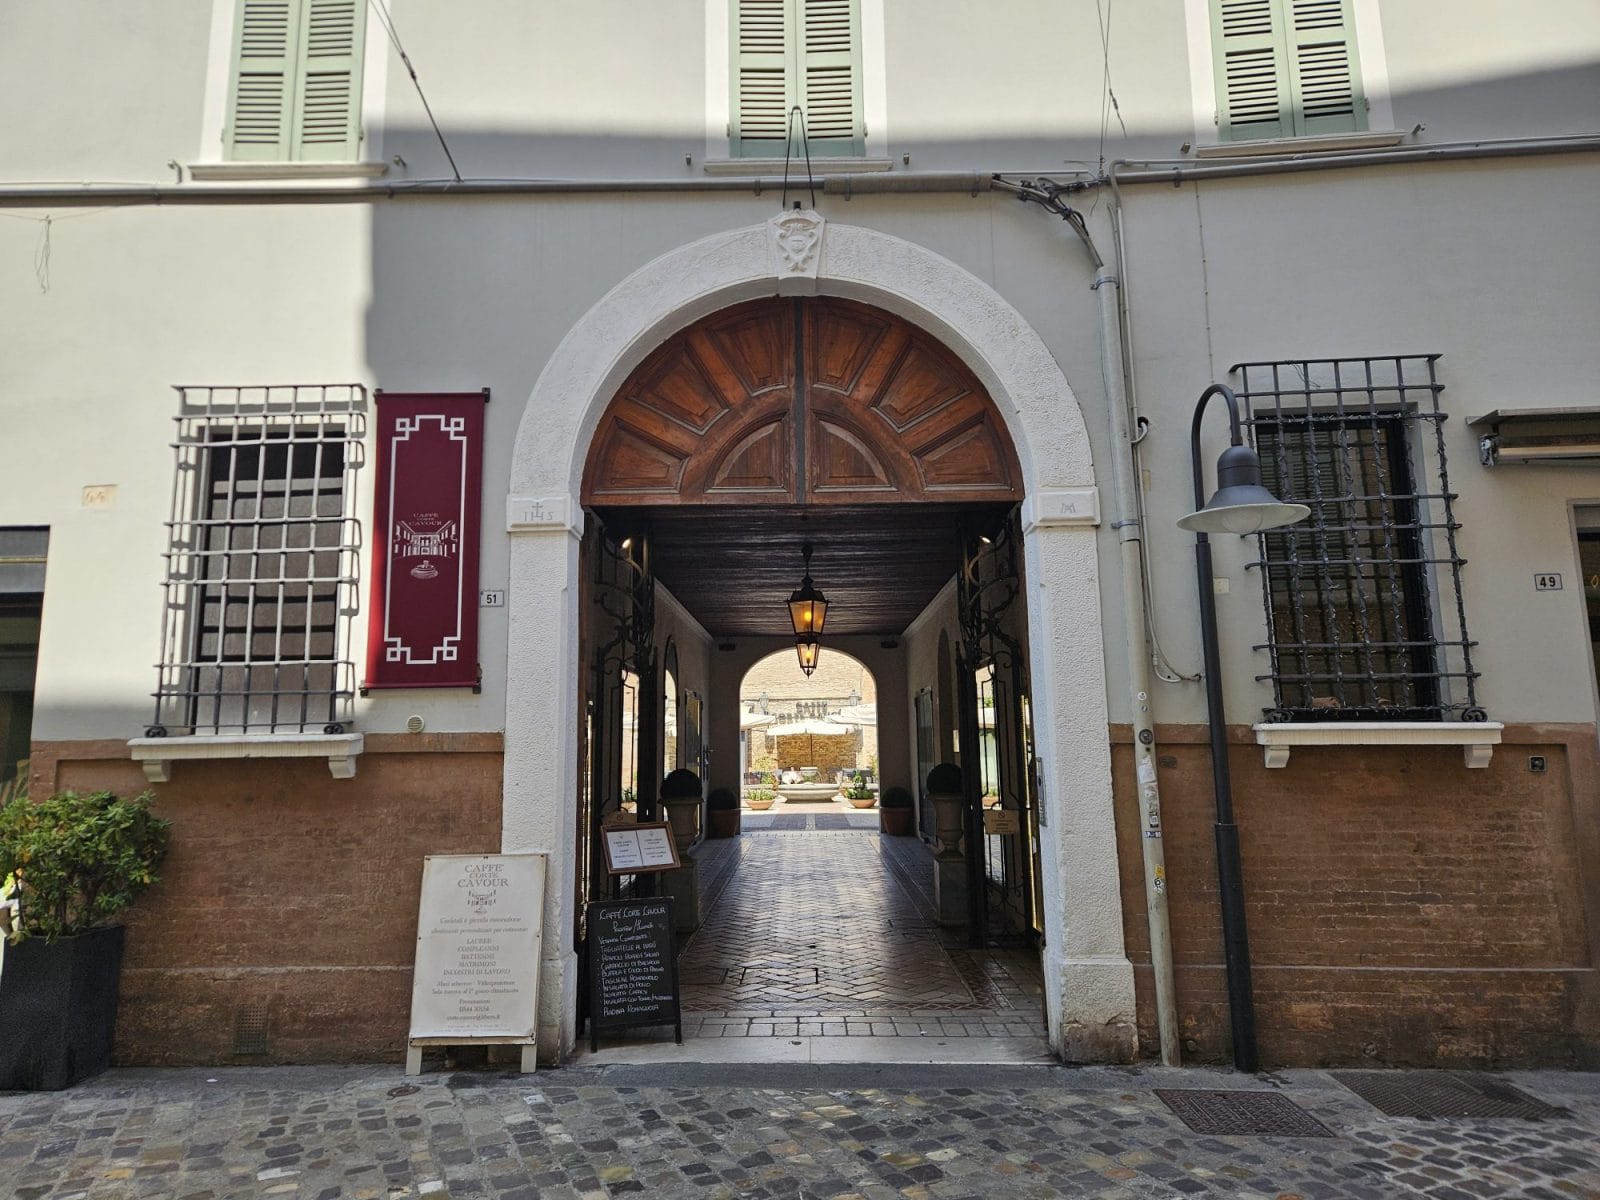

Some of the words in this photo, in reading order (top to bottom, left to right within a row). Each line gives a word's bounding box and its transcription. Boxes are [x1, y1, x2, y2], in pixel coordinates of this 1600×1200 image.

[1539, 576, 1556, 587] 49
[486, 593, 497, 604] 51
[457, 879, 509, 888] CAVOUR
